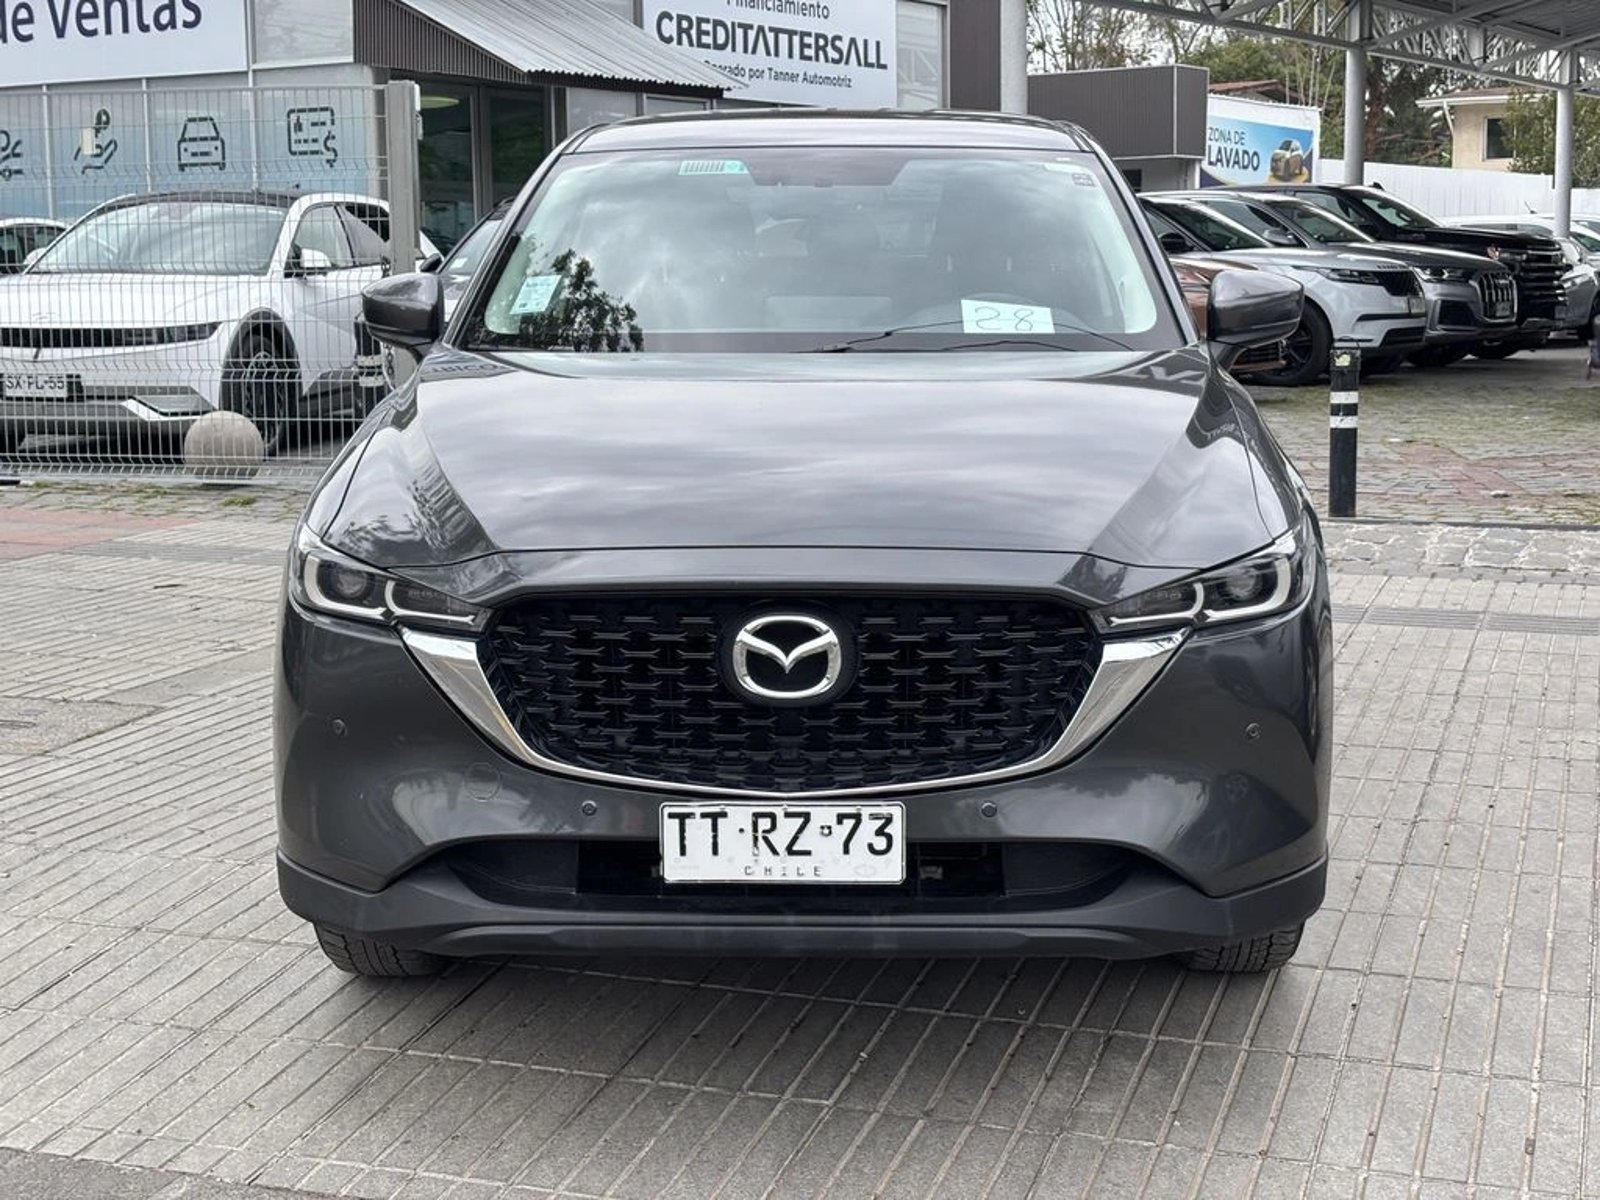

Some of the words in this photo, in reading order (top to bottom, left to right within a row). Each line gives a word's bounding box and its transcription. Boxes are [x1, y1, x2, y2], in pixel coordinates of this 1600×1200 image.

[0, 0, 34, 43] e
[47, 0, 202, 39] Ventas
[726, 0, 830, 19] nanciamiento
[655, 11, 888, 70] CREDITATTERSALL
[704, 60, 746, 78] rado
[748, 67, 765, 81] por
[767, 67, 800, 84] Tanner
[802, 73, 853, 88] Automotriz
[1208, 127, 1232, 145] ZONA
[1234, 130, 1246, 146] DE
[1207, 145, 1260, 171] LAVADO
[744, 865, 822, 876] CHILE
